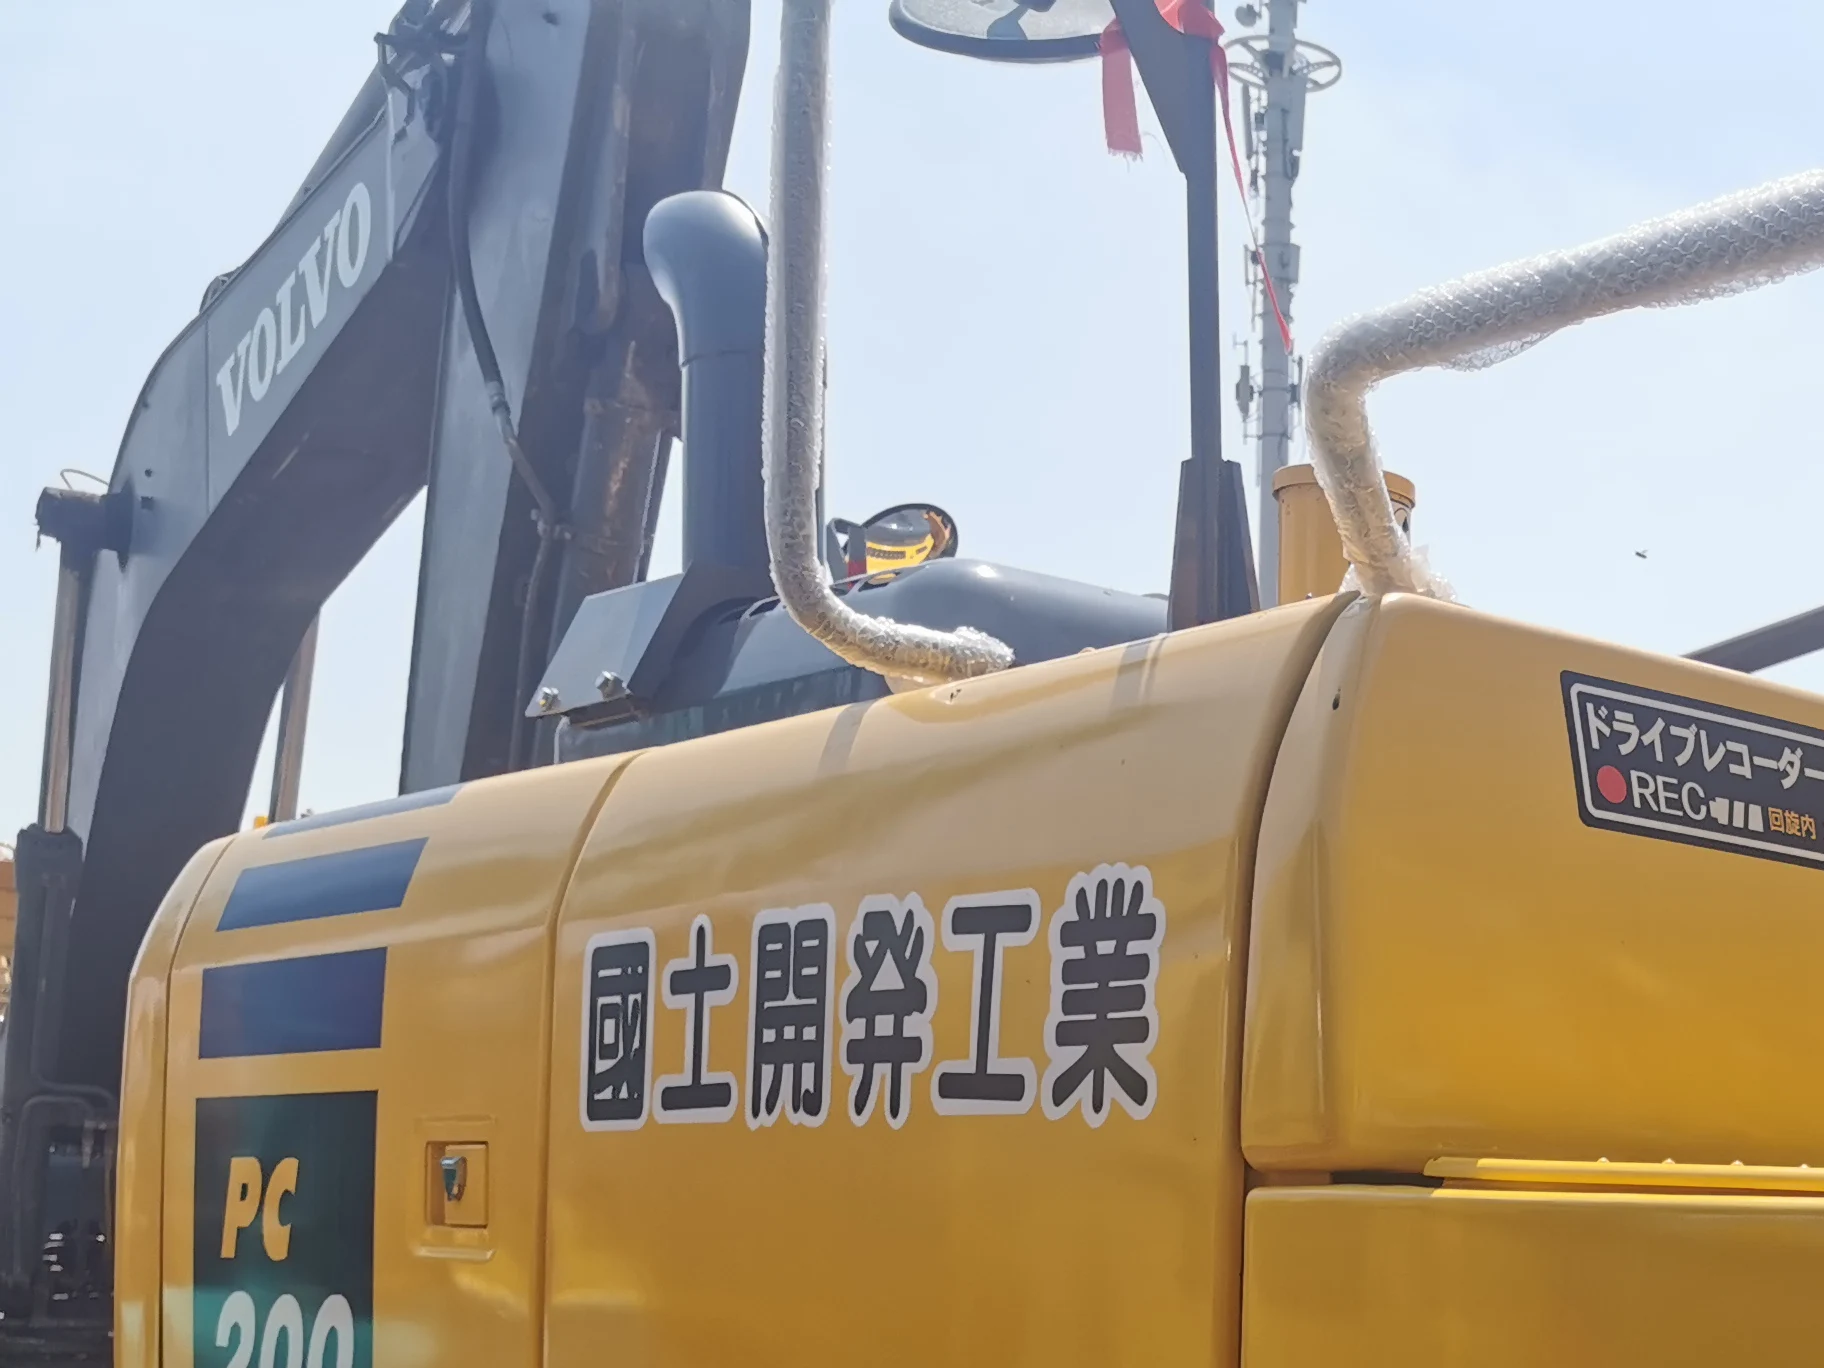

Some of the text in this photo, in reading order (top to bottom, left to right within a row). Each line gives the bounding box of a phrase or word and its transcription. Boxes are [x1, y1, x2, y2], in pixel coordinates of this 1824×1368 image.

[216, 182, 371, 436] VOLVO
[1630, 770, 1708, 821] REC
[580, 863, 1165, 1131] 國土開発工業
[220, 1156, 299, 1262] PC
